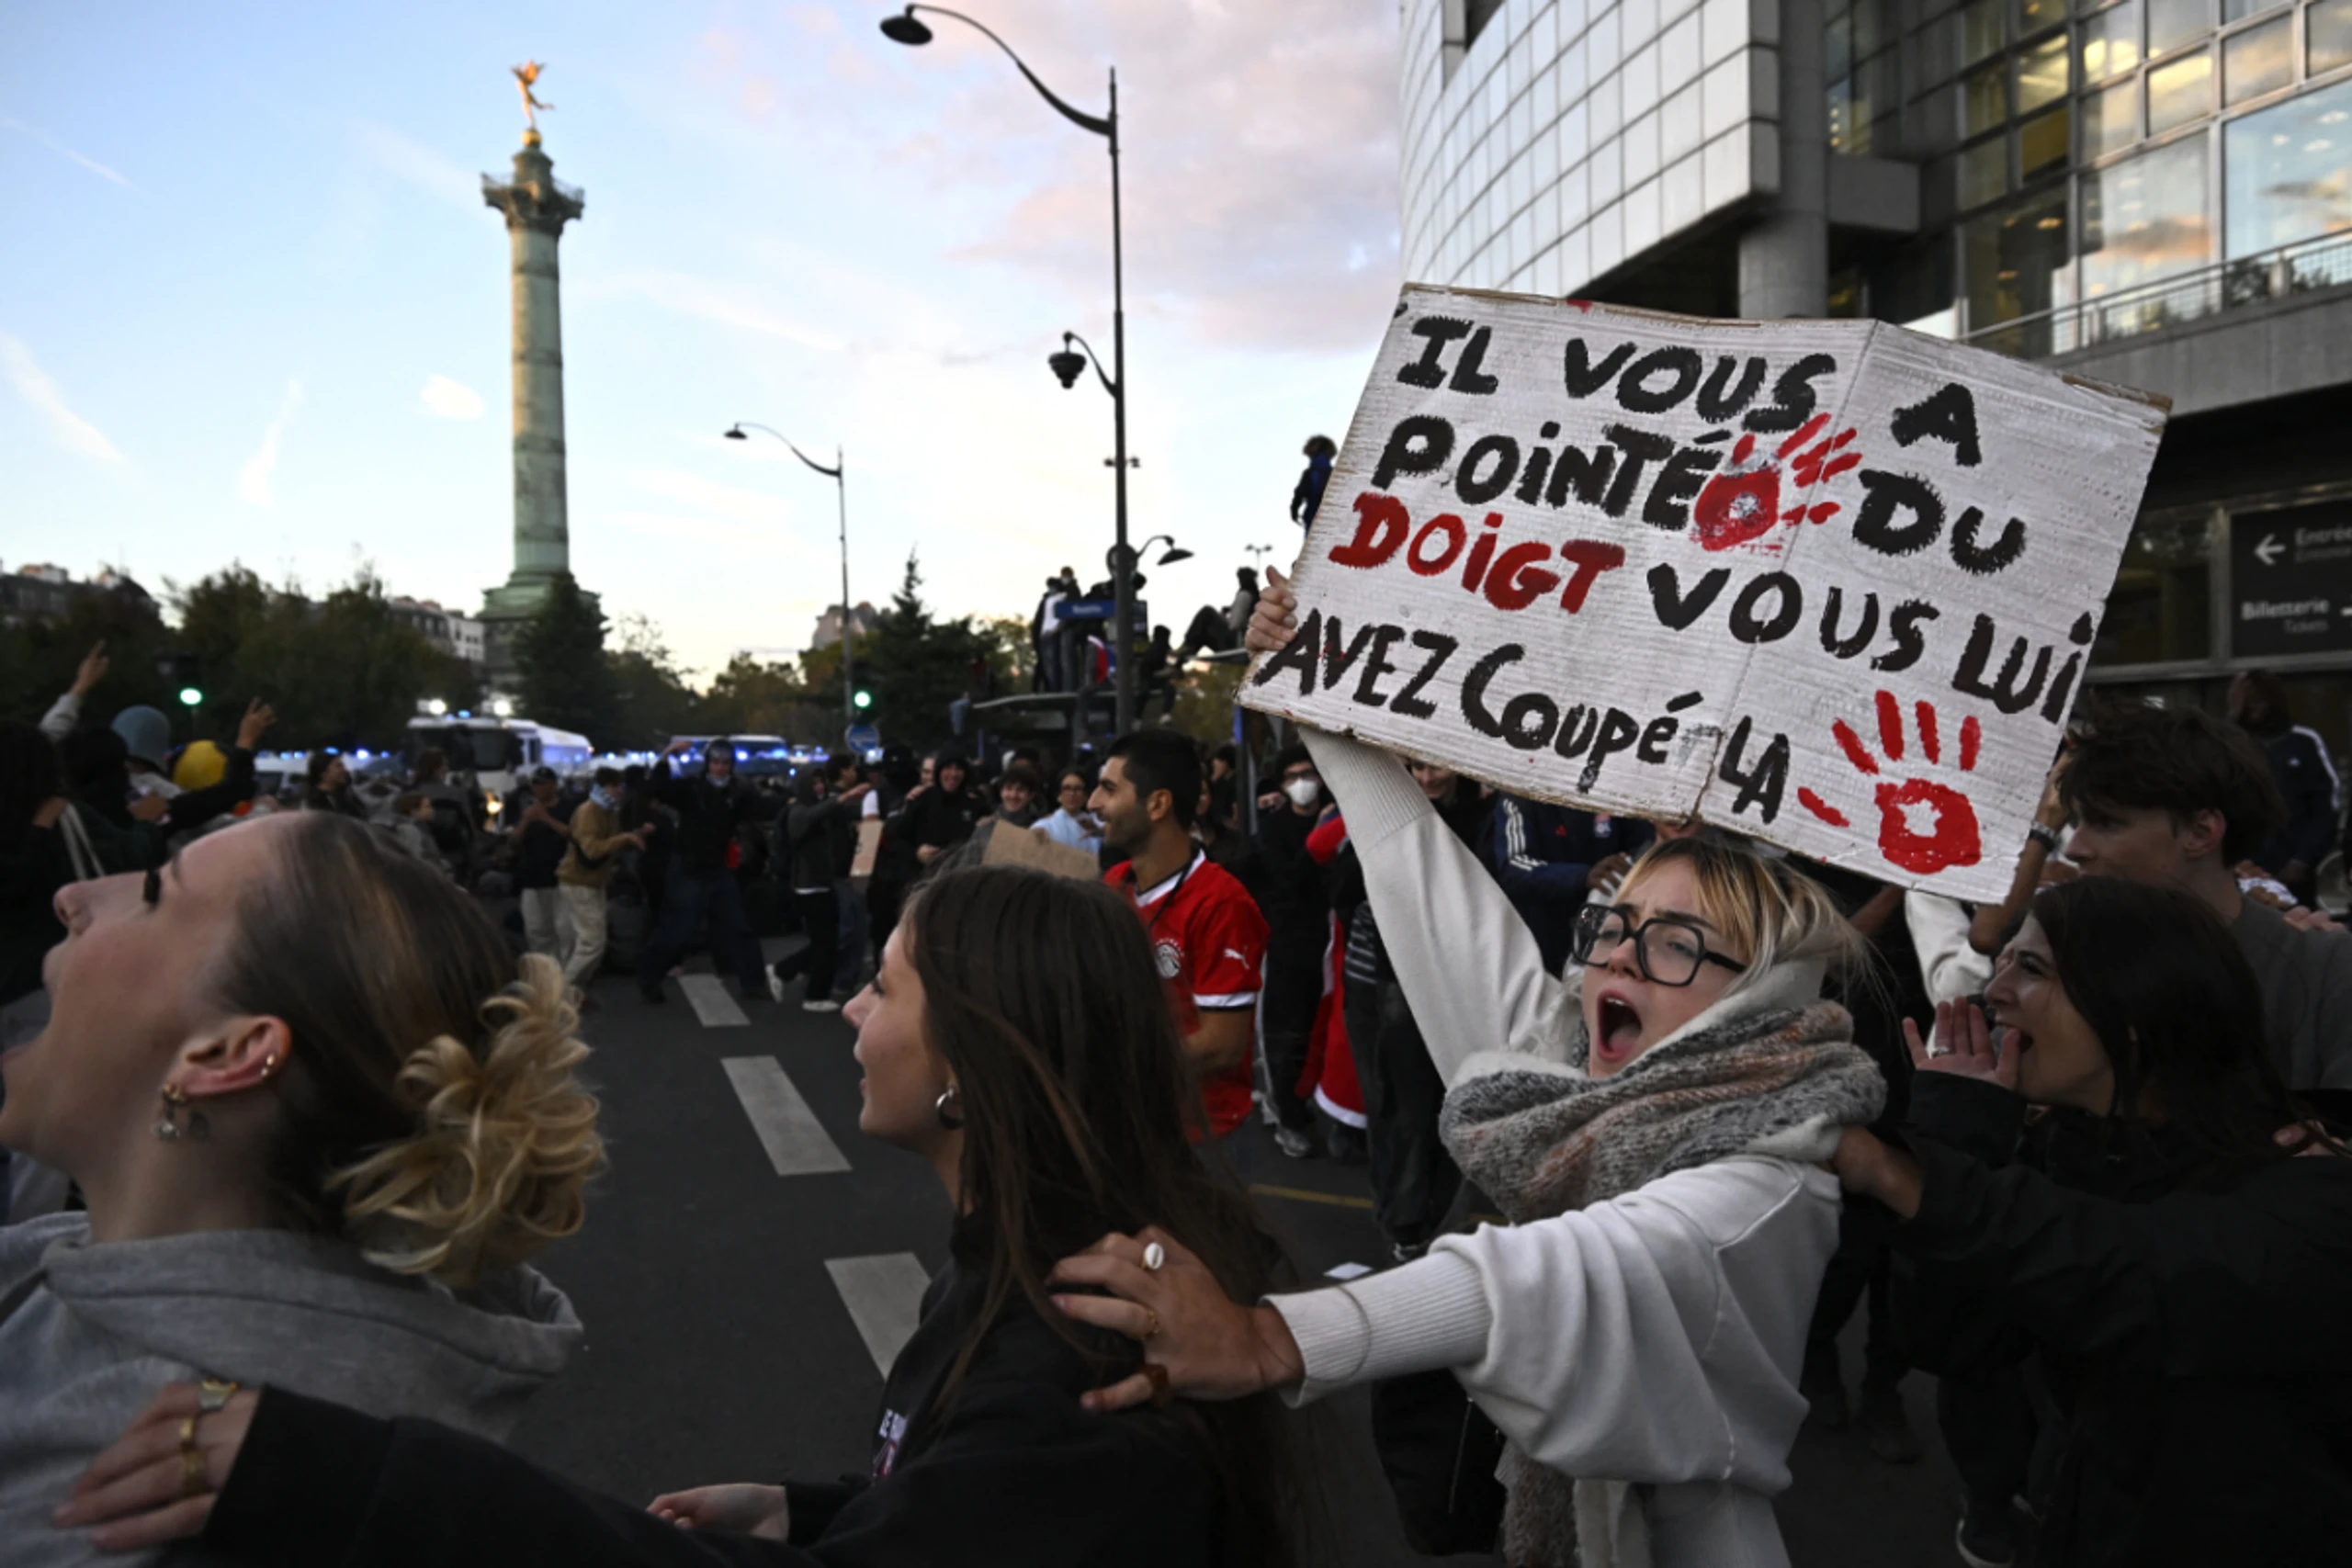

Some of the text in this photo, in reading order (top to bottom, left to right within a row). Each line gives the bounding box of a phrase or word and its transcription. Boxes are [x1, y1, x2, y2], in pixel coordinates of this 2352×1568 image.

[1397, 316, 1981, 467] IL VOUS A
[1852, 469, 2025, 575] DU
[1647, 563, 1939, 671] VOUS
[1253, 609, 1458, 718] AVEZ
[1719, 716, 1790, 820] LA
